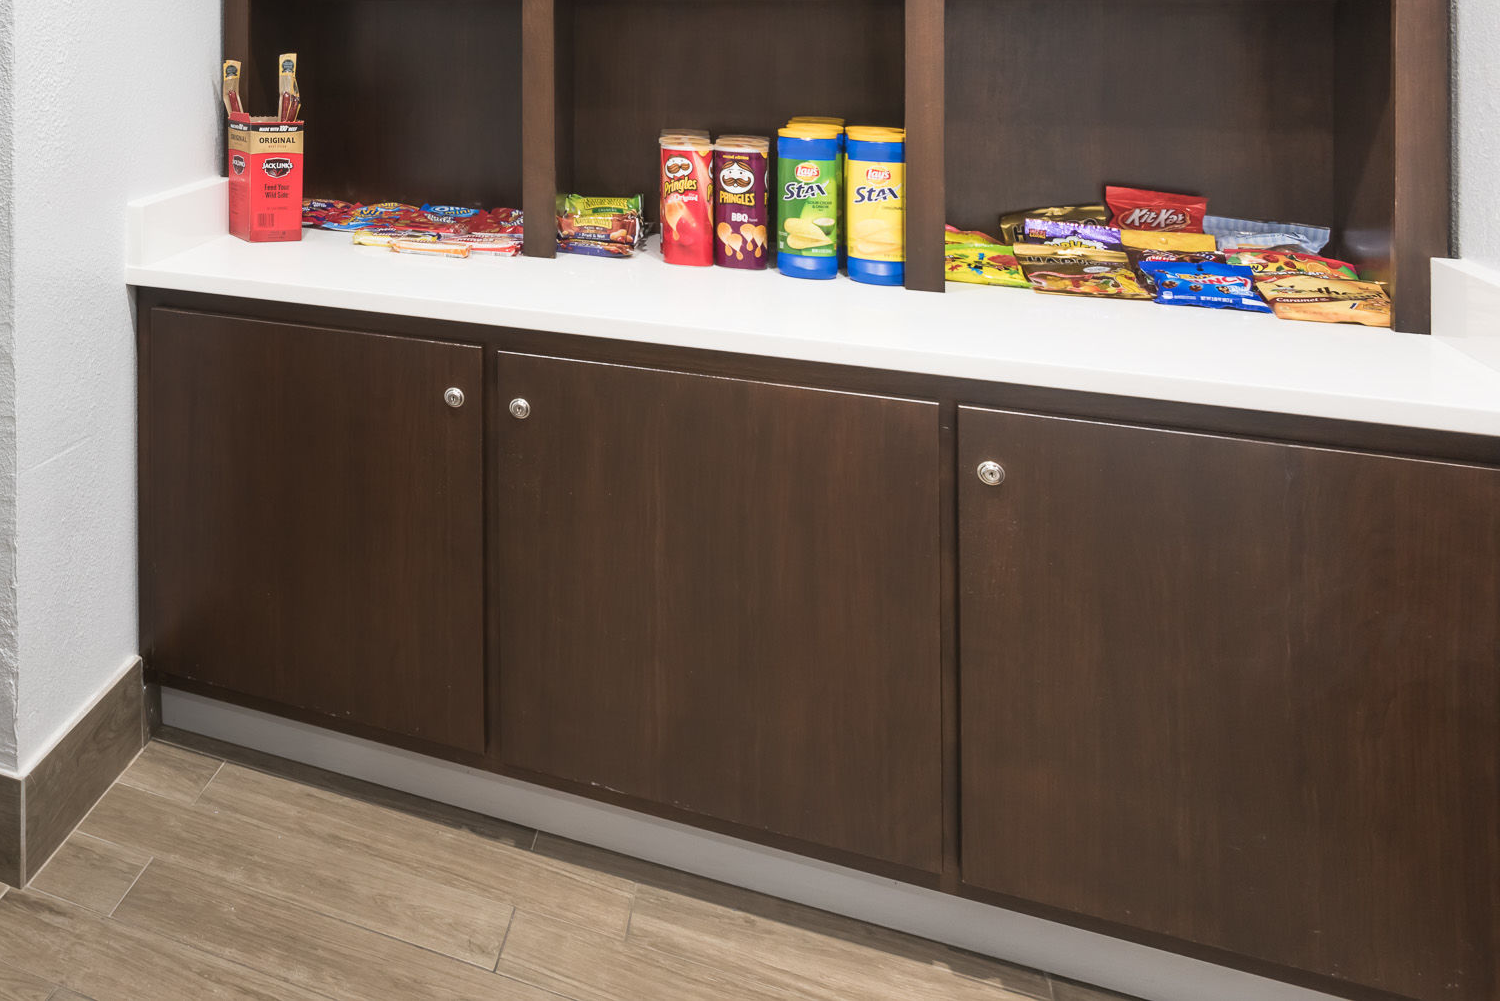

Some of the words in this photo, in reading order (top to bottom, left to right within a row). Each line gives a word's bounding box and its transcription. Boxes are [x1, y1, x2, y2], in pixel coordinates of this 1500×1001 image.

[262, 162, 276, 170] JACK
[796, 166, 820, 177] Lay's
[866, 169, 892, 180] Lay's
[664, 176, 698, 199] Pringles
[265, 191, 277, 199] Wild
[277, 191, 289, 199] Side
[719, 190, 755, 207] PRINGLES
[731, 212, 749, 223] BBQ
[1275, 296, 1319, 304] Caramel
